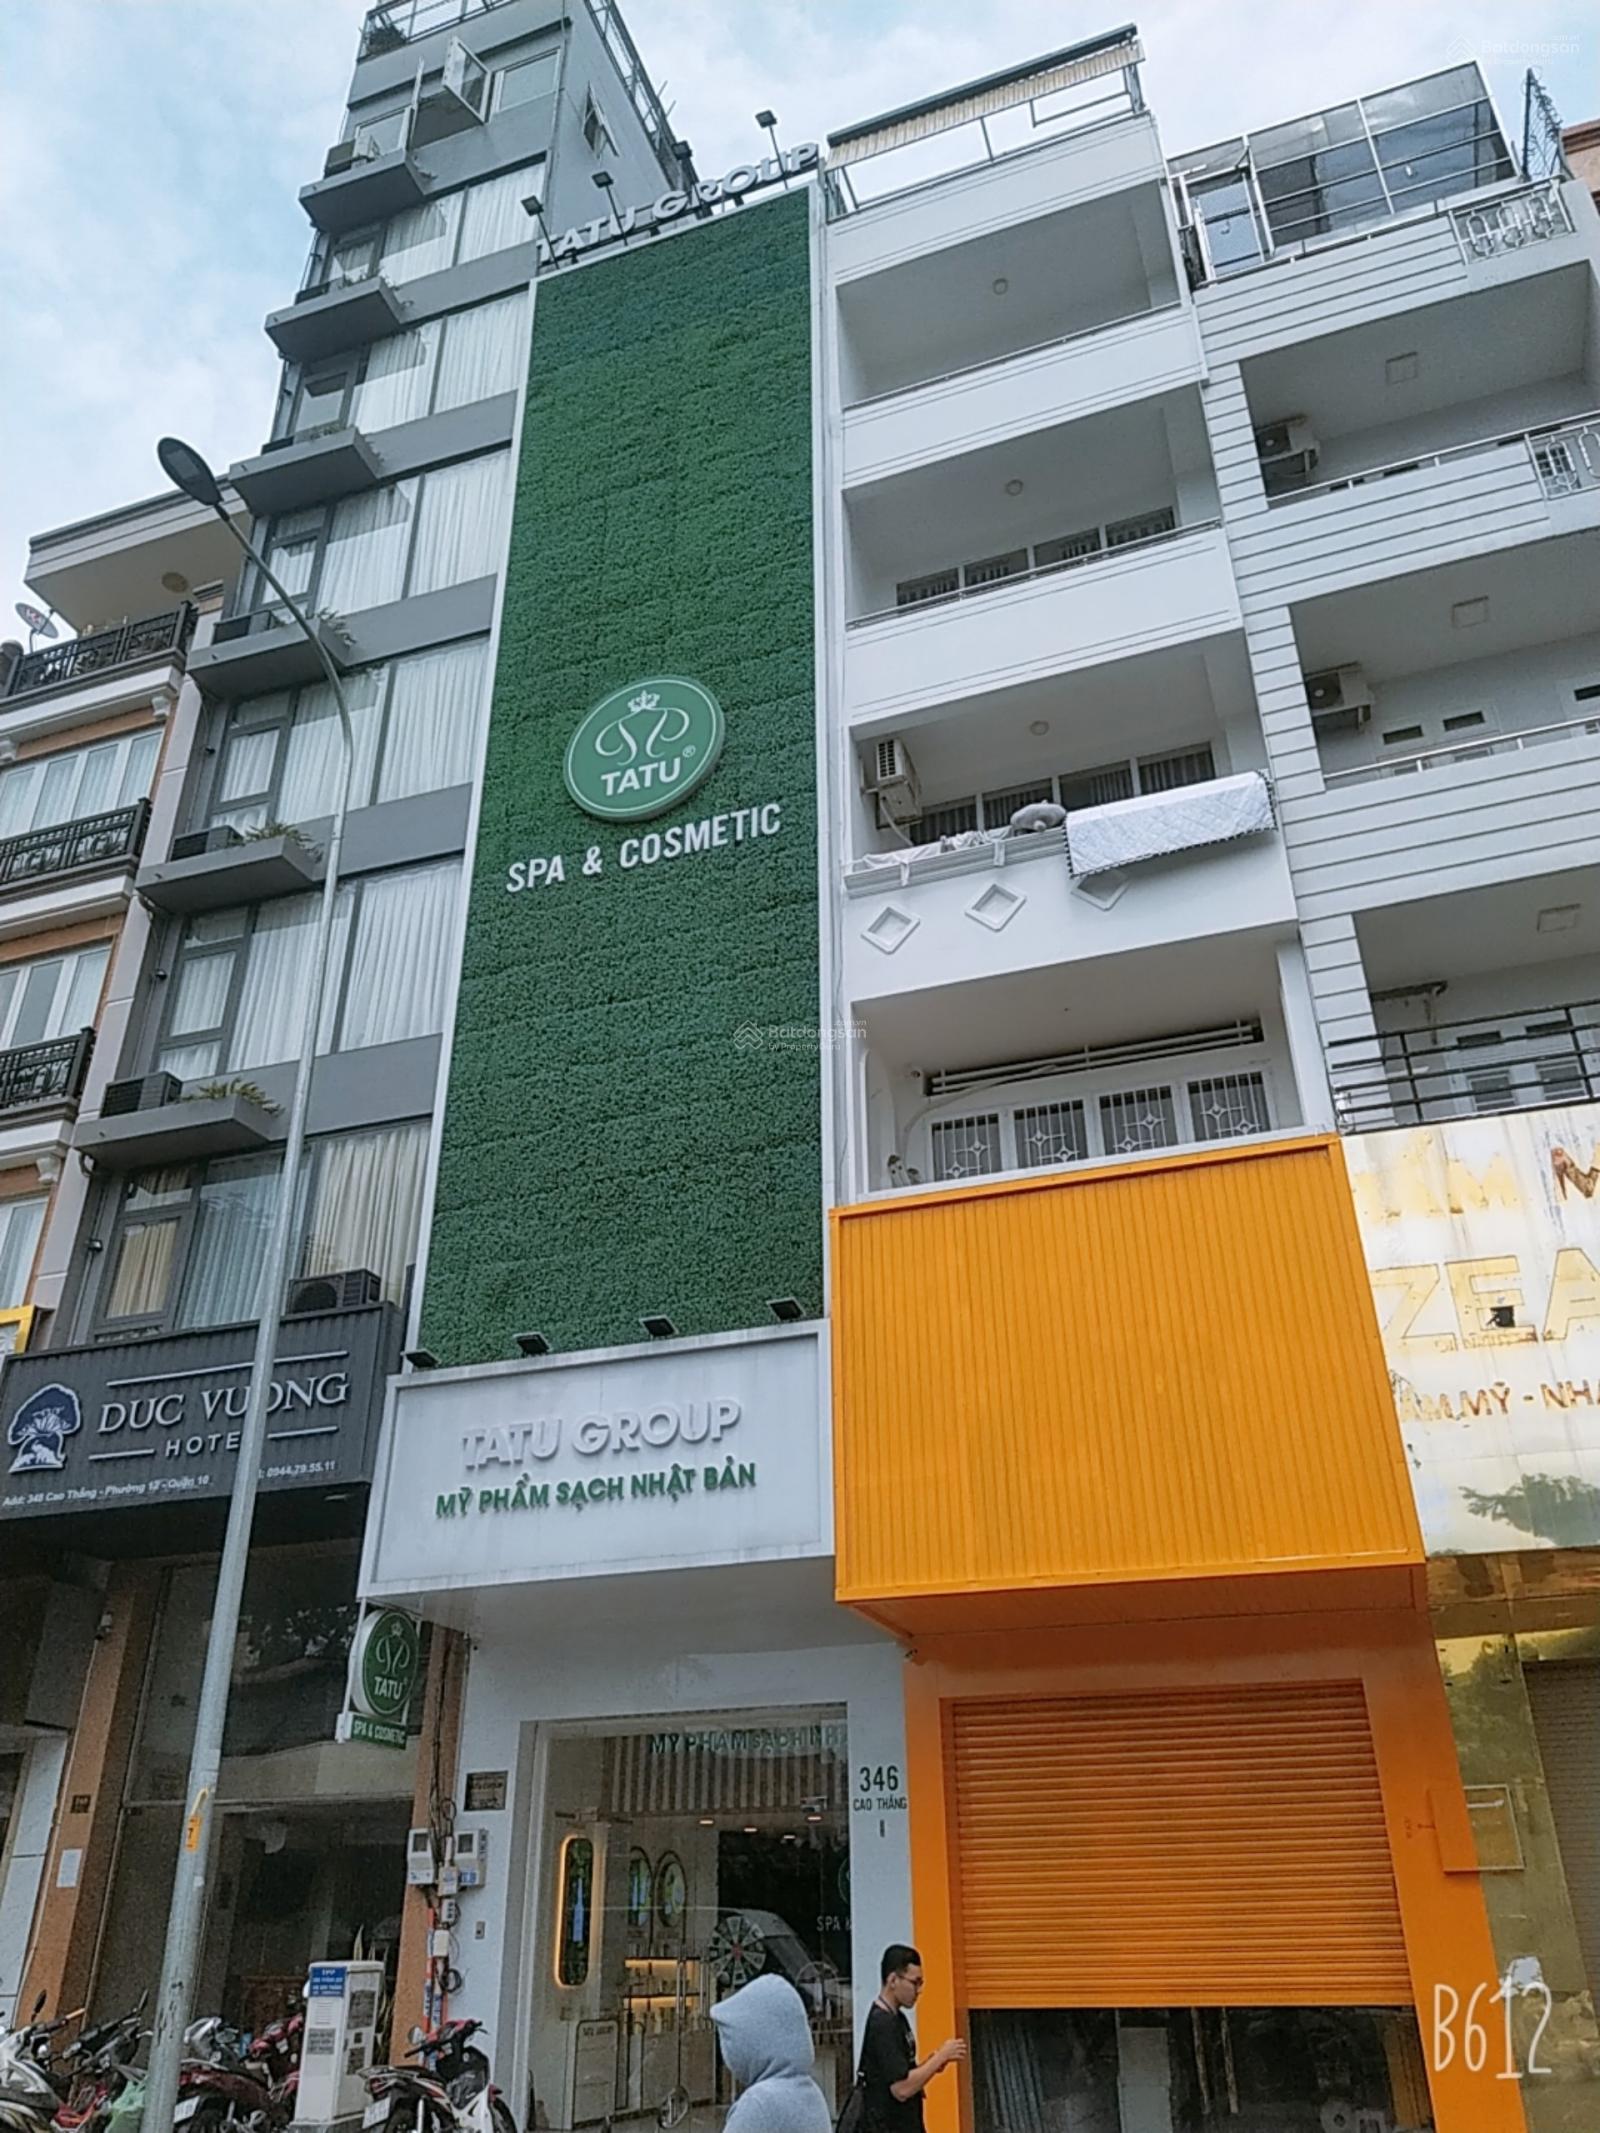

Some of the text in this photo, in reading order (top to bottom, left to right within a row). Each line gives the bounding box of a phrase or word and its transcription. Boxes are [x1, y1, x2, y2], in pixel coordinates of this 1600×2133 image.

[536, 142, 820, 262] TATU GROUP
[601, 756, 681, 796] TATU
[506, 802, 782, 893] SPA & COSMETIC
[97, 1394, 184, 1433] DUC
[165, 1431, 242, 1457] HOTE
[461, 1398, 742, 1471] TATU GROUP
[435, 1455, 757, 1519] MỸ PHẨM SẠCH NHẬT BẢN
[374, 1675, 403, 1700] TATU
[859, 1765, 899, 1792] 346
[853, 1798, 872, 1811] CAO
[816, 1916, 841, 1932] SPA
